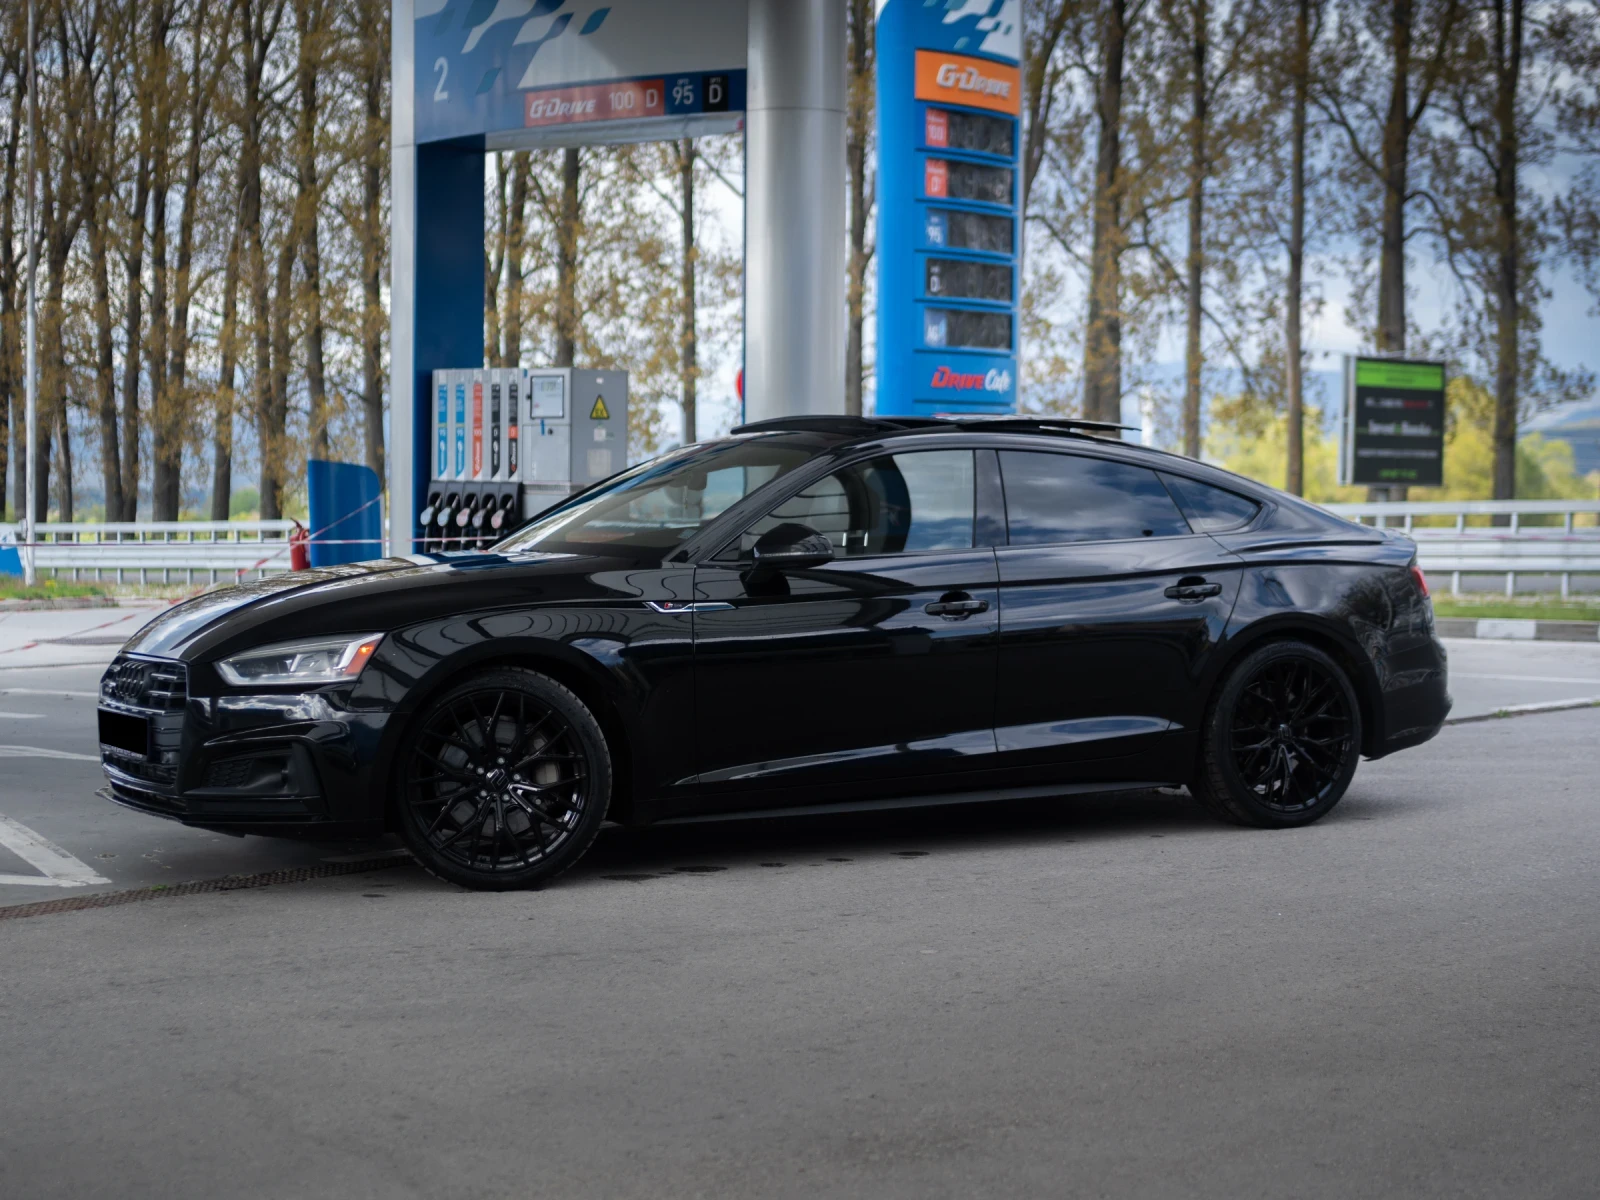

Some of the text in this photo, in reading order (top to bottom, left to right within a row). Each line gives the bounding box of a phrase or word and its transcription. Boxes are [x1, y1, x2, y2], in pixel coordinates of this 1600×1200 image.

[433, 56, 449, 103] 2
[609, 90, 635, 111] 100
[645, 88, 659, 108] D
[672, 85, 695, 106] 95
[709, 84, 723, 104] D
